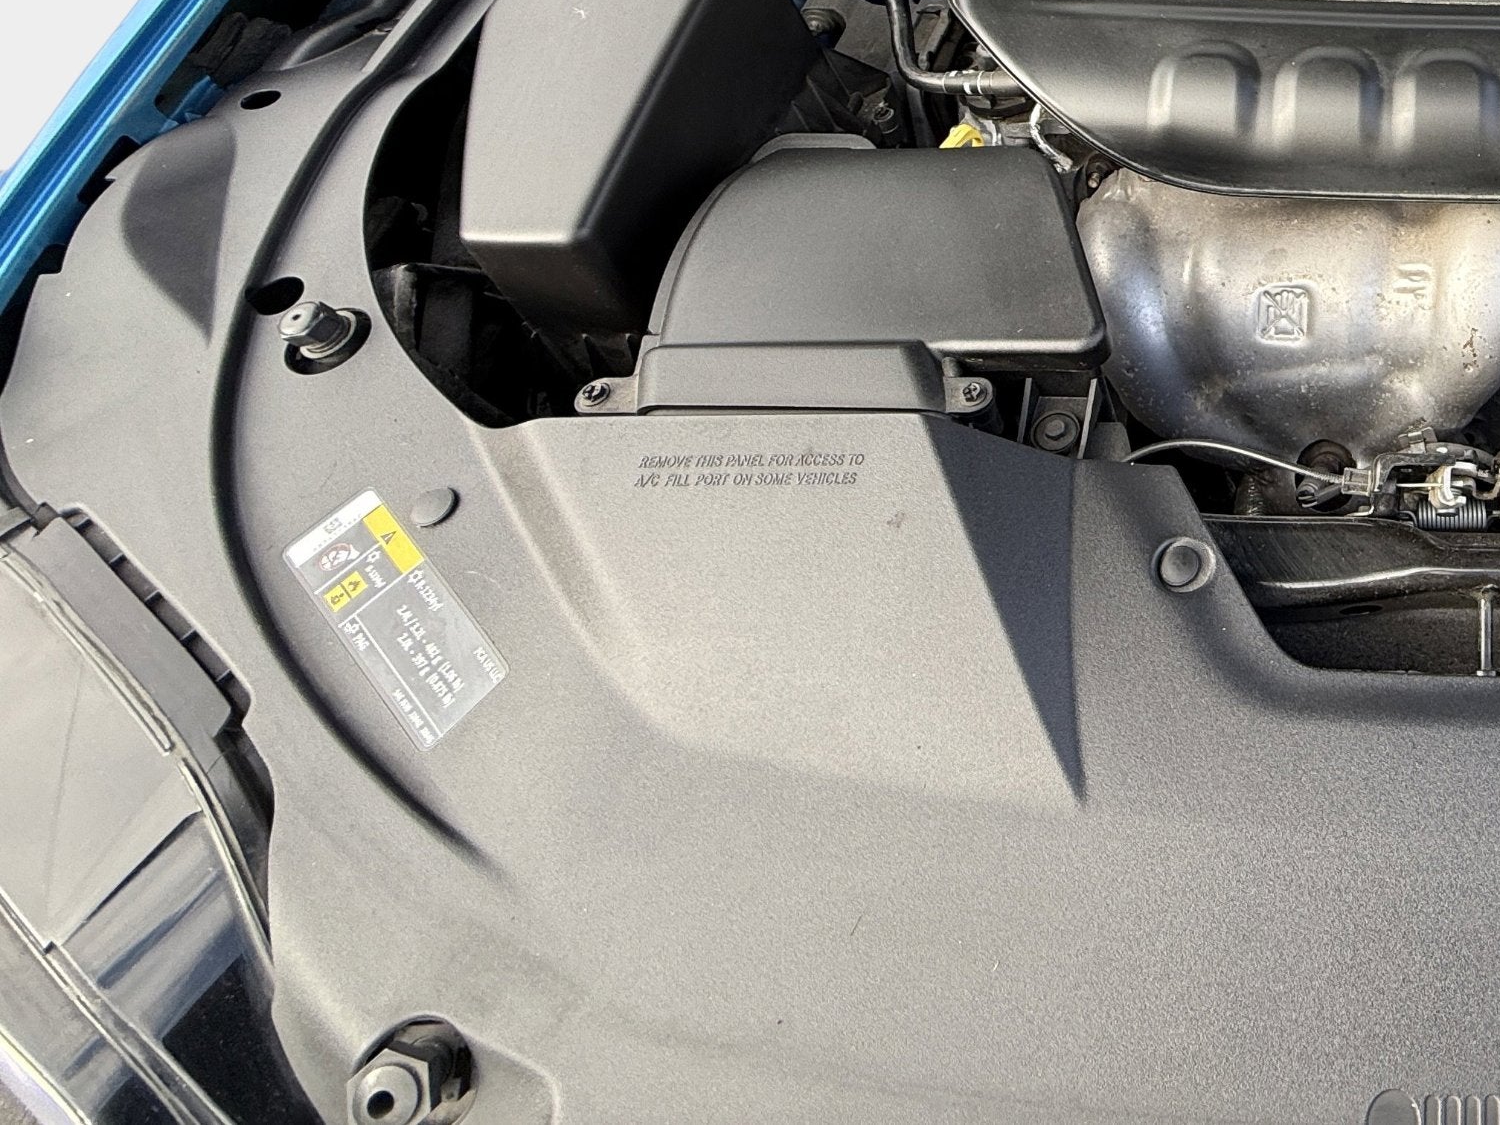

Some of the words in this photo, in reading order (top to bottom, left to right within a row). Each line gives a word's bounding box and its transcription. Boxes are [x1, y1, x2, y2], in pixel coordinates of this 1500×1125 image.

[638, 455, 693, 468] REMOVE
[694, 454, 723, 468] THIS
[725, 453, 765, 467] PANEL
[768, 453, 794, 467] FOR
[795, 453, 845, 467] ACCESS
[848, 453, 865, 466] TO
[634, 473, 660, 487] A/C
[664, 473, 690, 487] FILL
[694, 473, 728, 486] PORT
[732, 473, 751, 485] ON
[755, 473, 792, 485] SOME
[797, 472, 858, 485] VEHICLES
